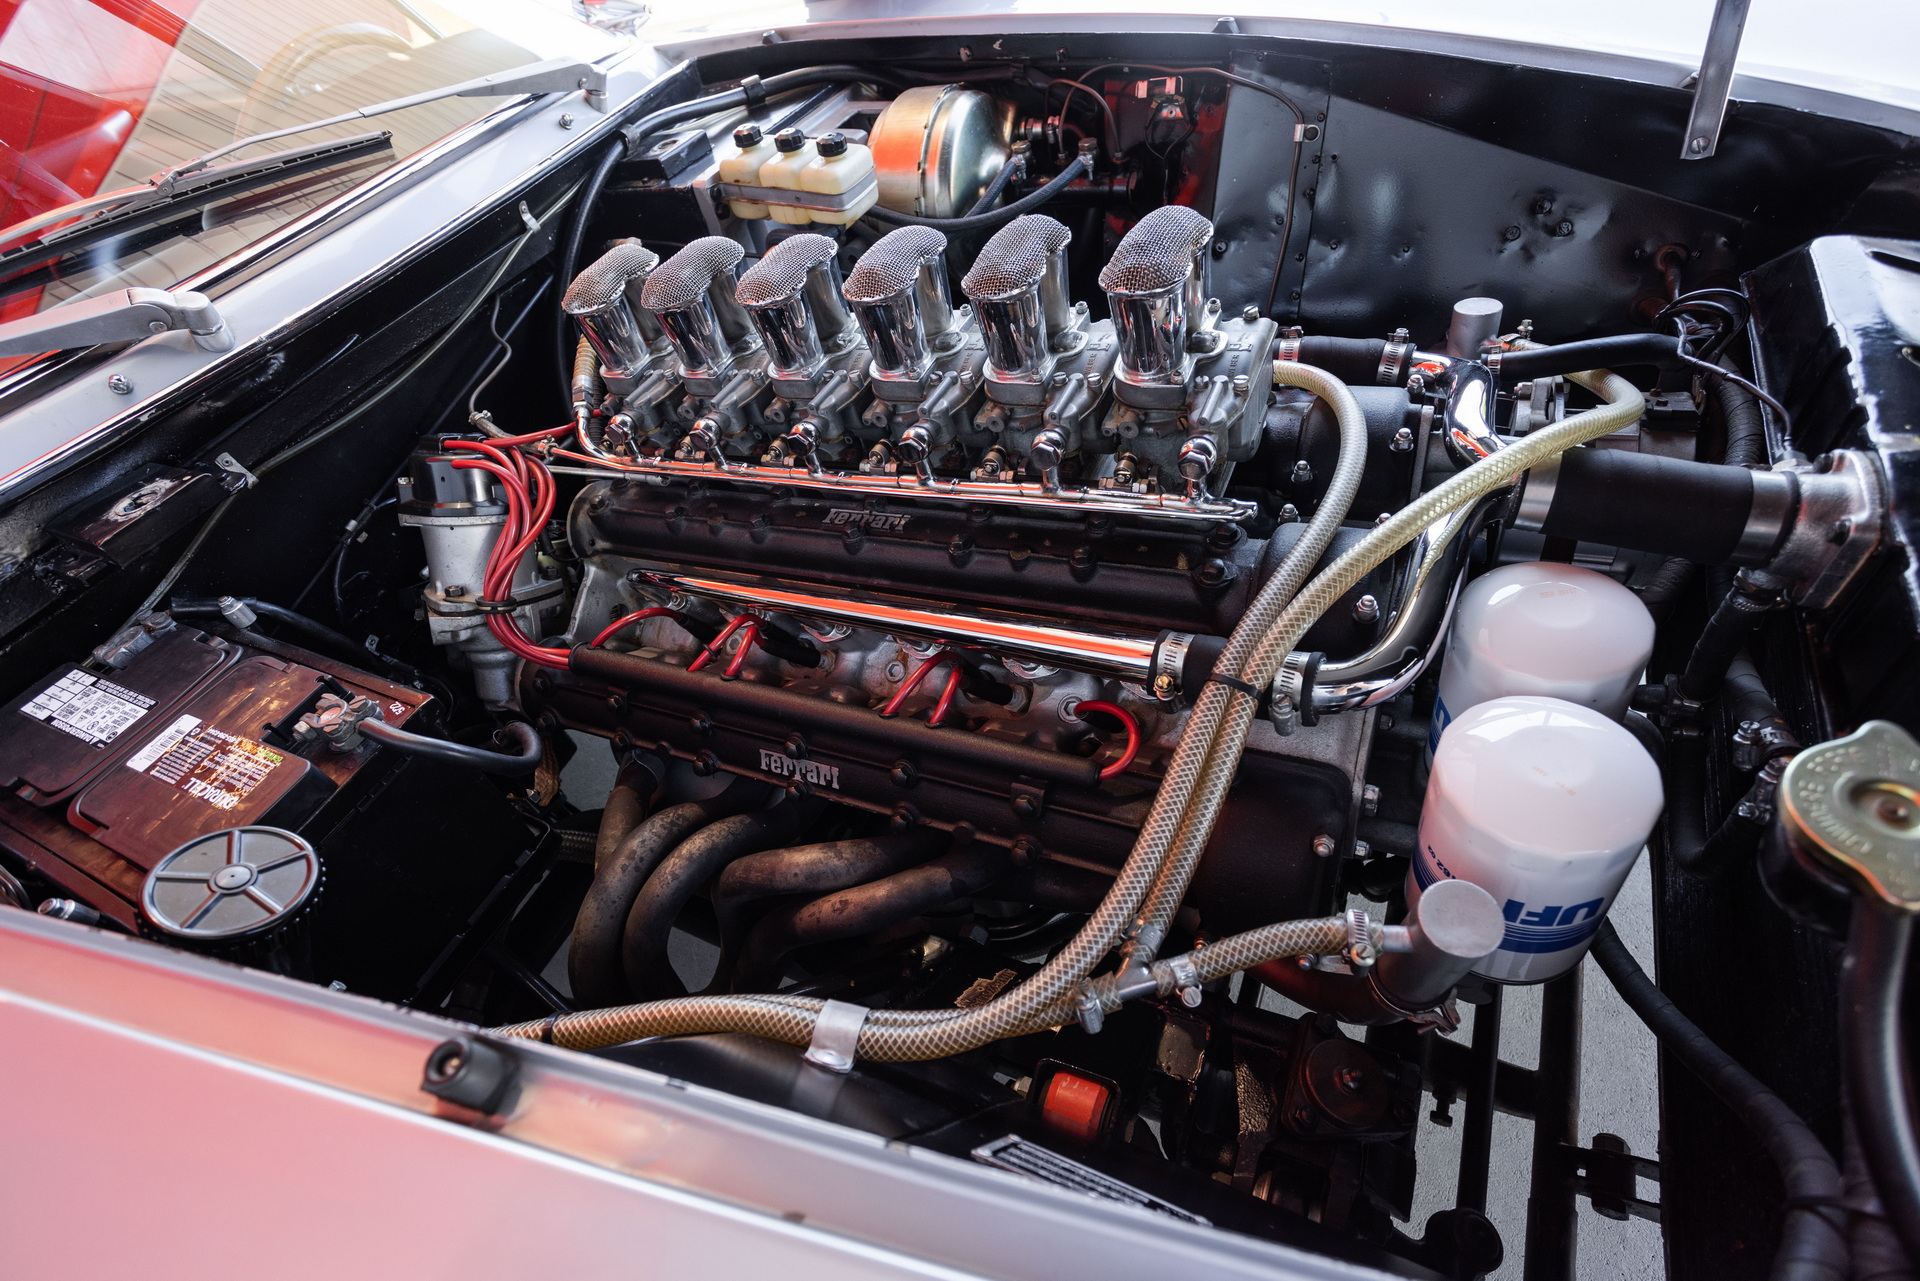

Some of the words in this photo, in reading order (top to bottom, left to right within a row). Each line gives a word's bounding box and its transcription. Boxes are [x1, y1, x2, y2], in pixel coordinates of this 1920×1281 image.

[822, 508, 911, 534] Ferrari
[759, 748, 840, 790] Ferrari
[181, 776, 239, 810] DURACELL
[1502, 897, 1605, 927] UFI
